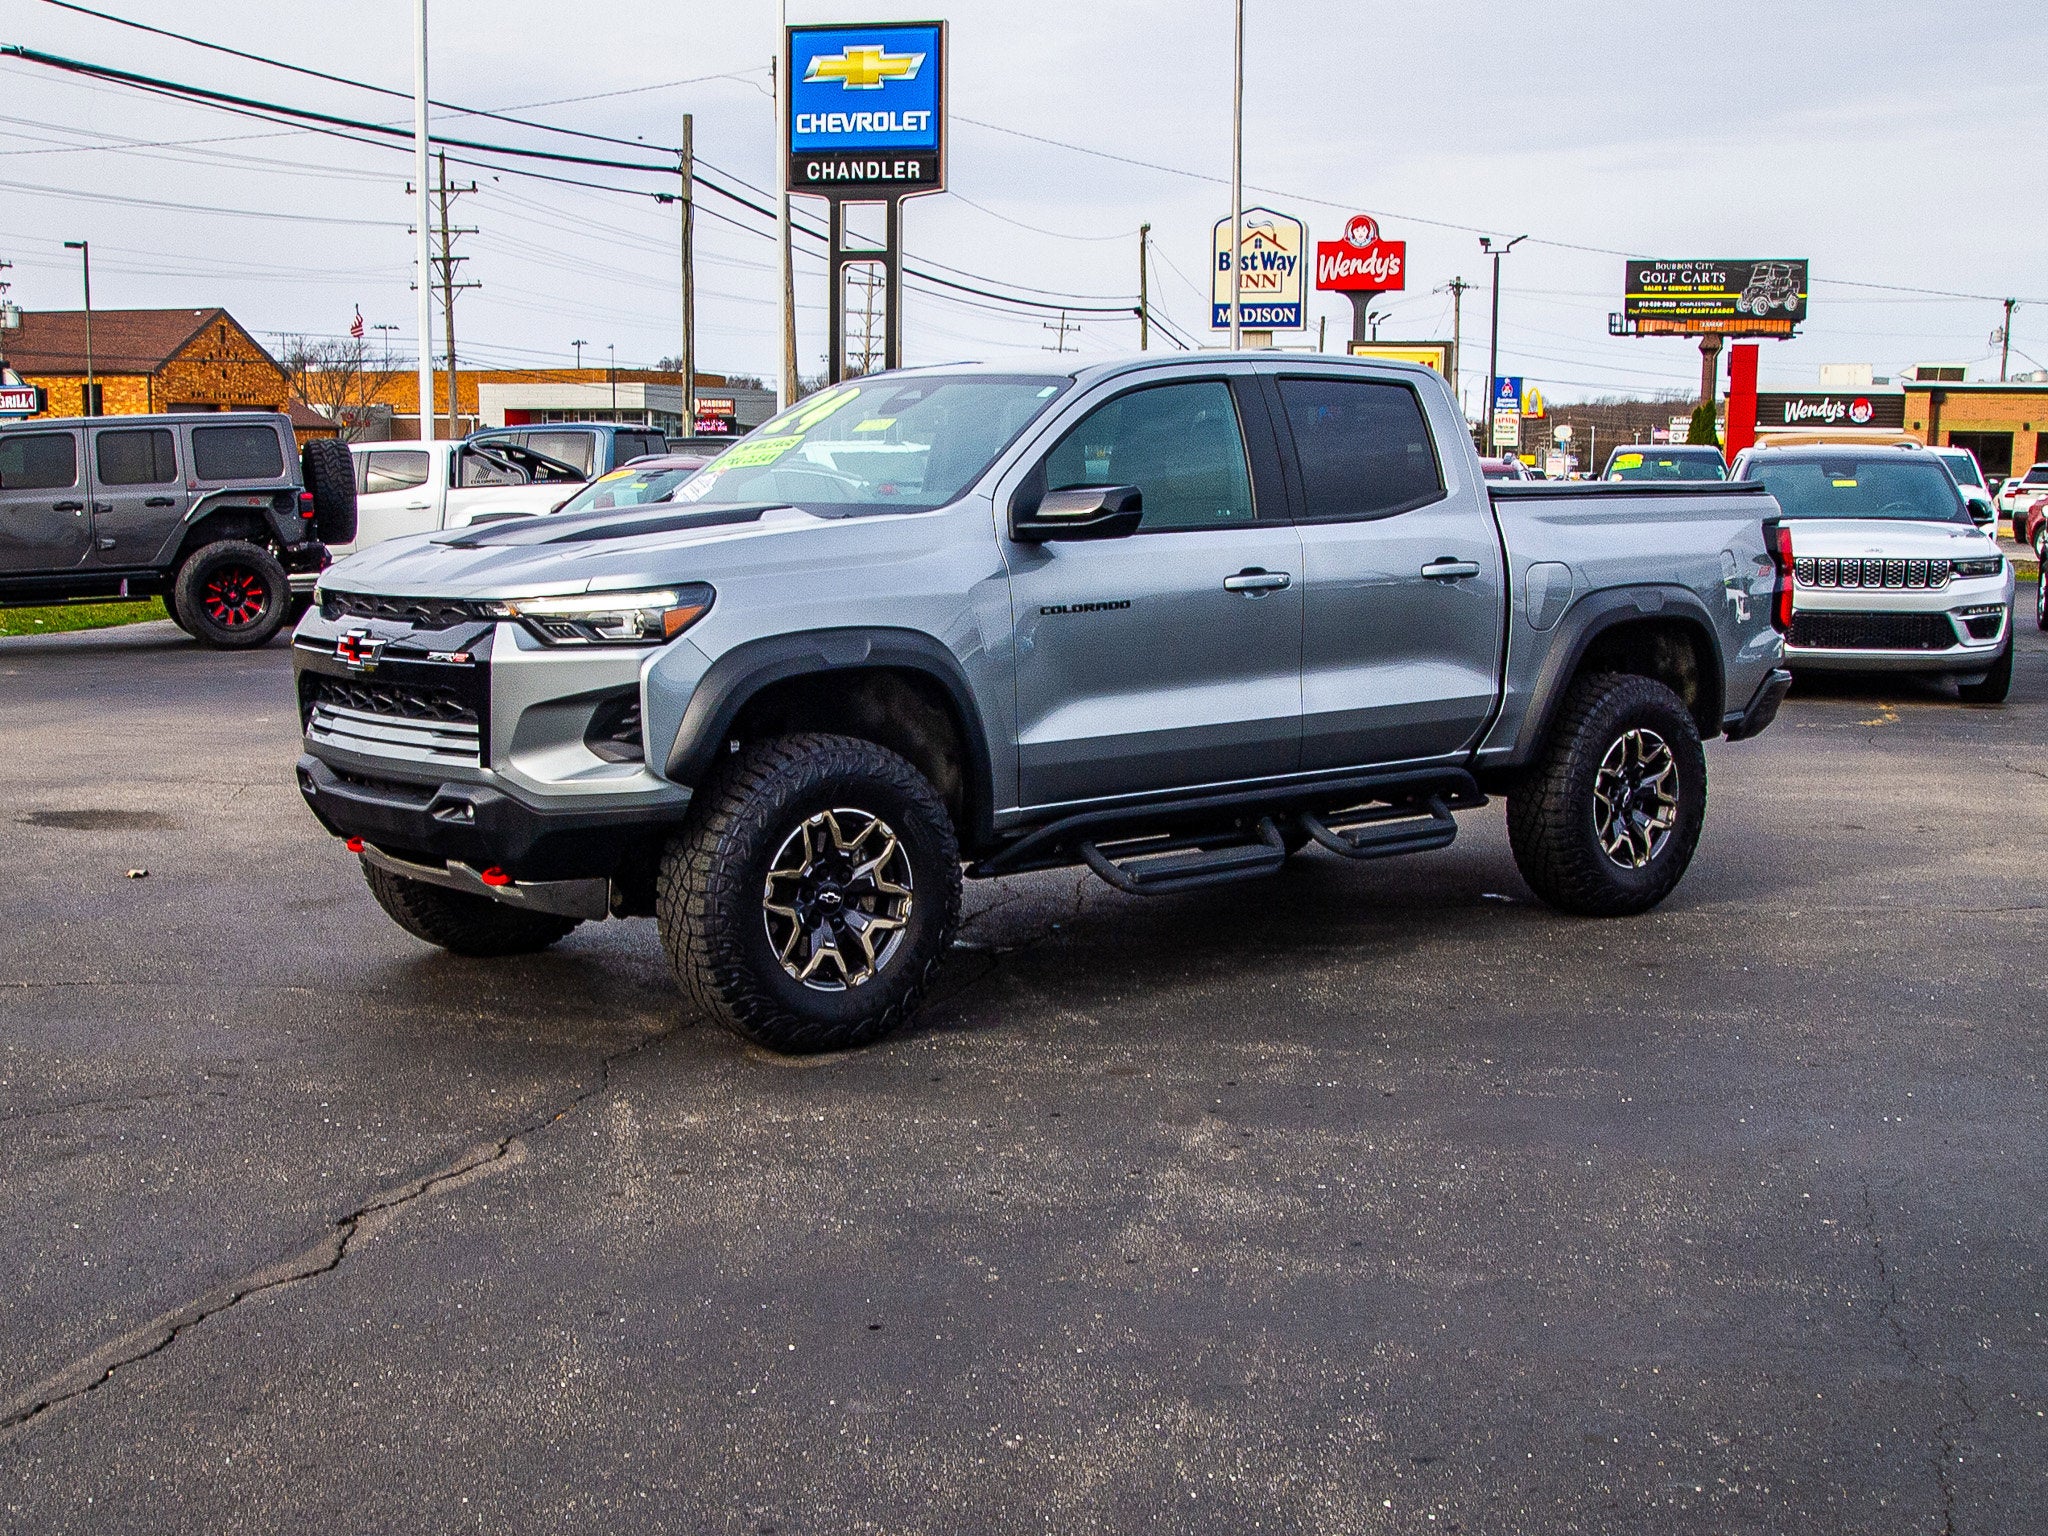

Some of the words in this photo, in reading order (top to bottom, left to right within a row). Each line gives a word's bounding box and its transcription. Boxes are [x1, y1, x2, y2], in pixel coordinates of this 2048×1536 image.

[796, 110, 931, 134] CHEVROLET
[807, 161, 920, 180] CHANDLER
[1219, 251, 1258, 271] Bst
[1260, 251, 1297, 277] Way
[1319, 248, 1401, 284] Wendy's
[1695, 262, 1714, 270] CITY
[1240, 274, 1277, 288] INN
[1640, 270, 1676, 283] GOLF
[1681, 270, 1726, 284] CARTS
[1217, 307, 1296, 323] MDISON
[700, 399, 731, 408] MADISON
[1784, 397, 1845, 423] Wendy's
[1040, 600, 1131, 615] COLORADO
